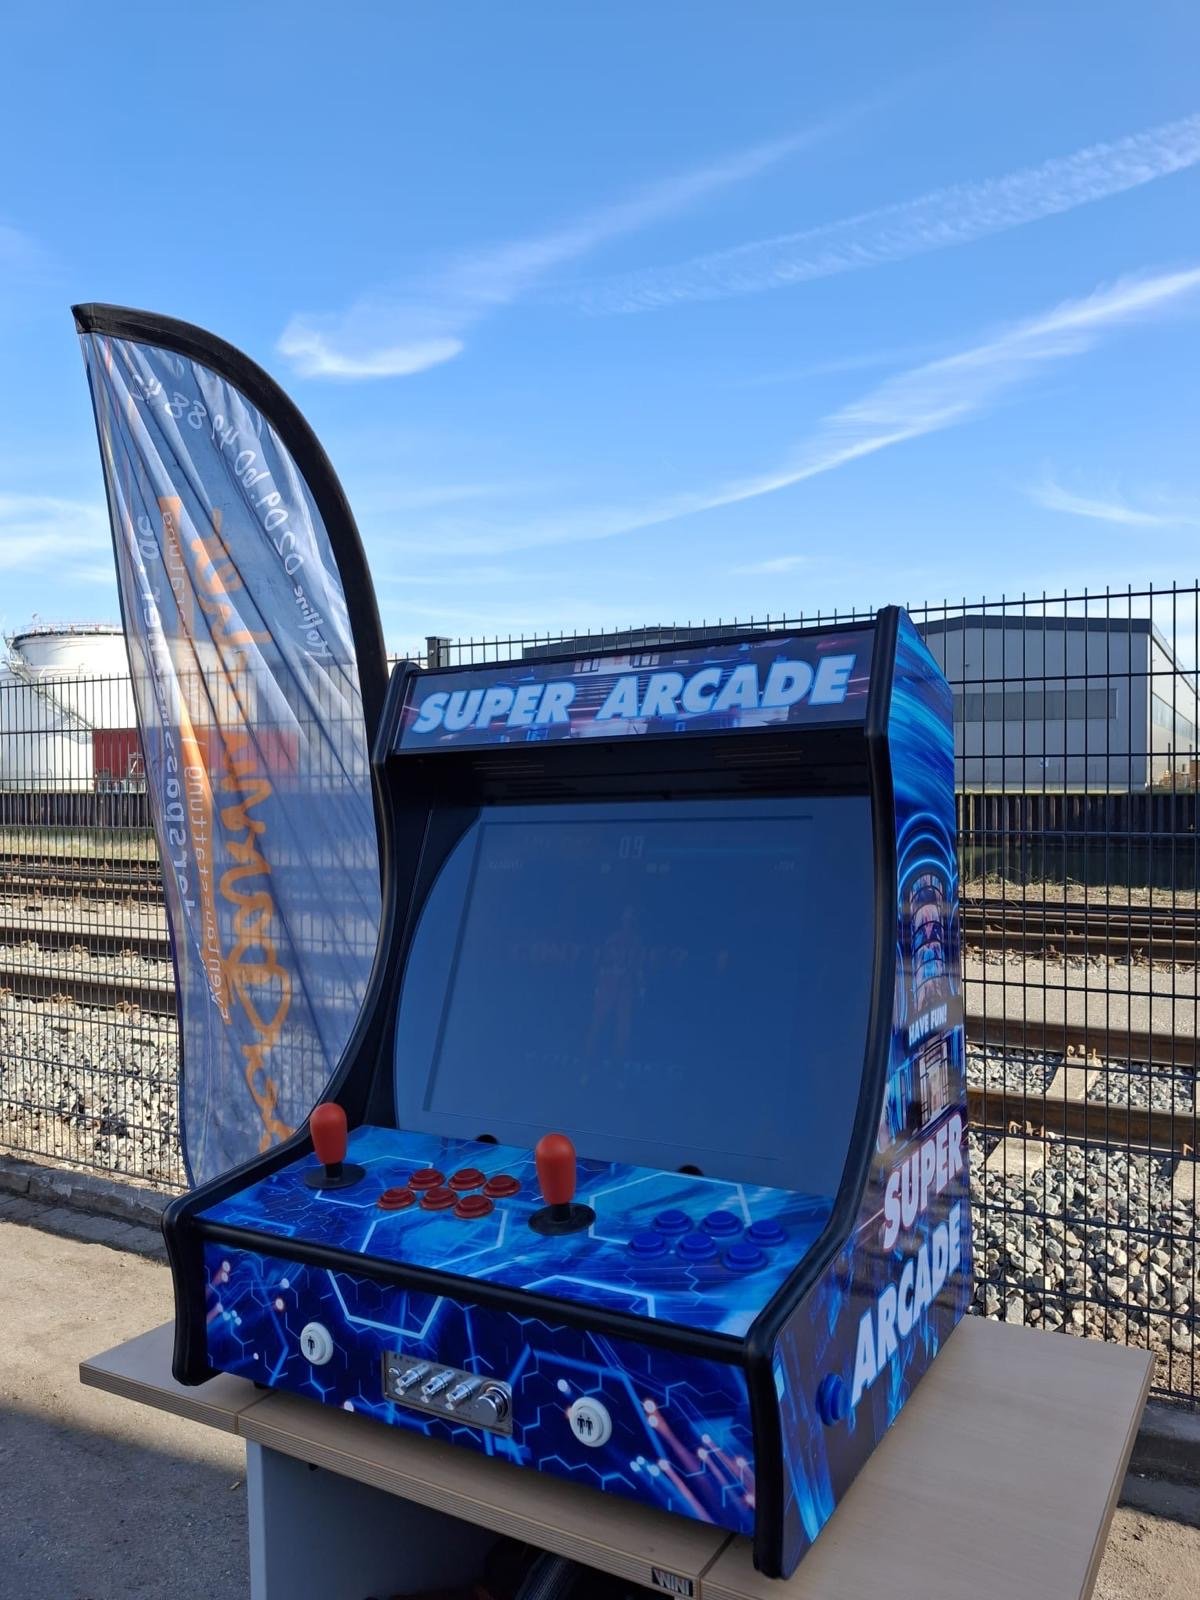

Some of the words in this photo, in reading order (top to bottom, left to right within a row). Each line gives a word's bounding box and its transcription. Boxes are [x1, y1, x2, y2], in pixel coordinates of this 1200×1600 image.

[411, 681, 577, 734] SUPER
[594, 654, 857, 720] ARCADE
[908, 1011, 931, 1047] HAVE
[930, 1003, 948, 1031] FUN!
[883, 1113, 965, 1253] SUPER
[850, 1201, 962, 1409] ARCADE
